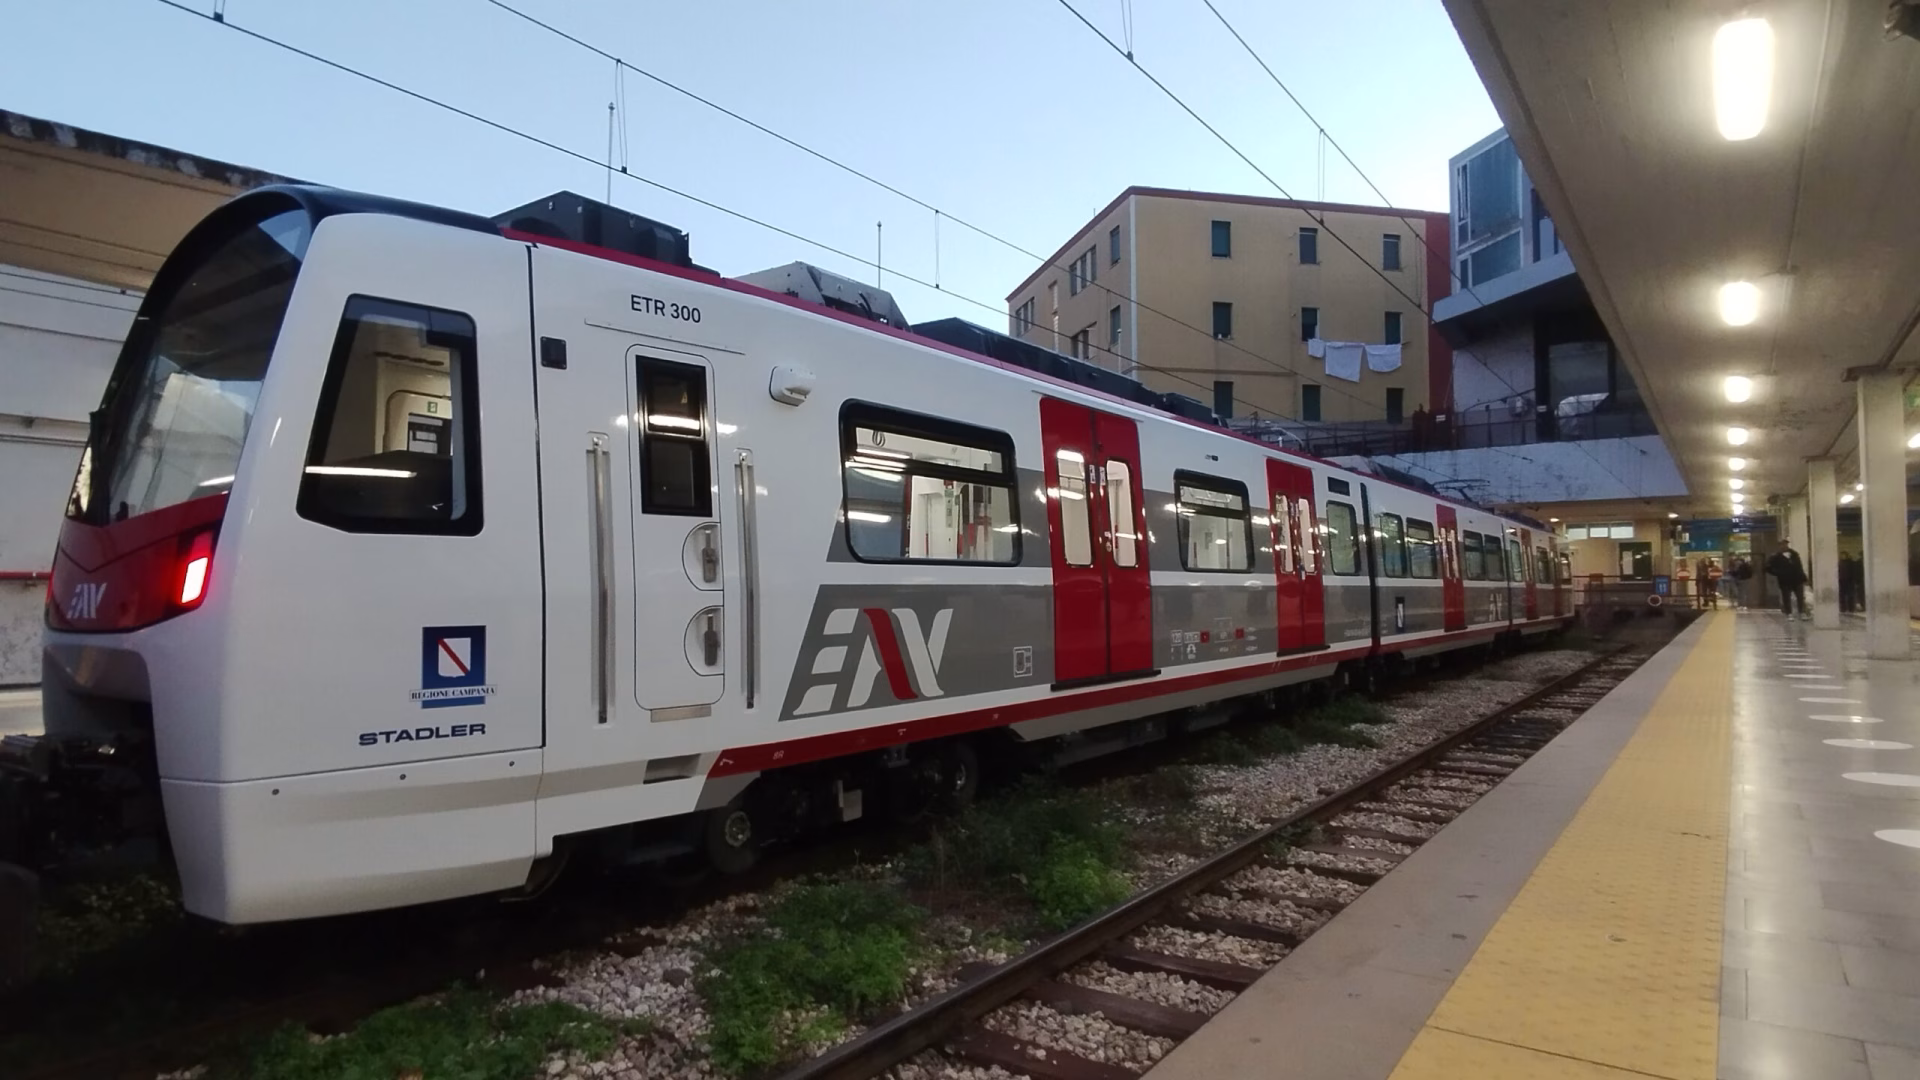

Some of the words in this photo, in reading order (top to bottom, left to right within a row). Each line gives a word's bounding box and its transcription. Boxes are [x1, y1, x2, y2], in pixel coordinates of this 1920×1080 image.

[631, 294, 666, 317] ETR
[670, 303, 701, 323] 300
[792, 608, 954, 716] EAV
[411, 689, 450, 700] REGIONE
[452, 687, 495, 697] CAMPANIA
[359, 724, 486, 746] STADLER
